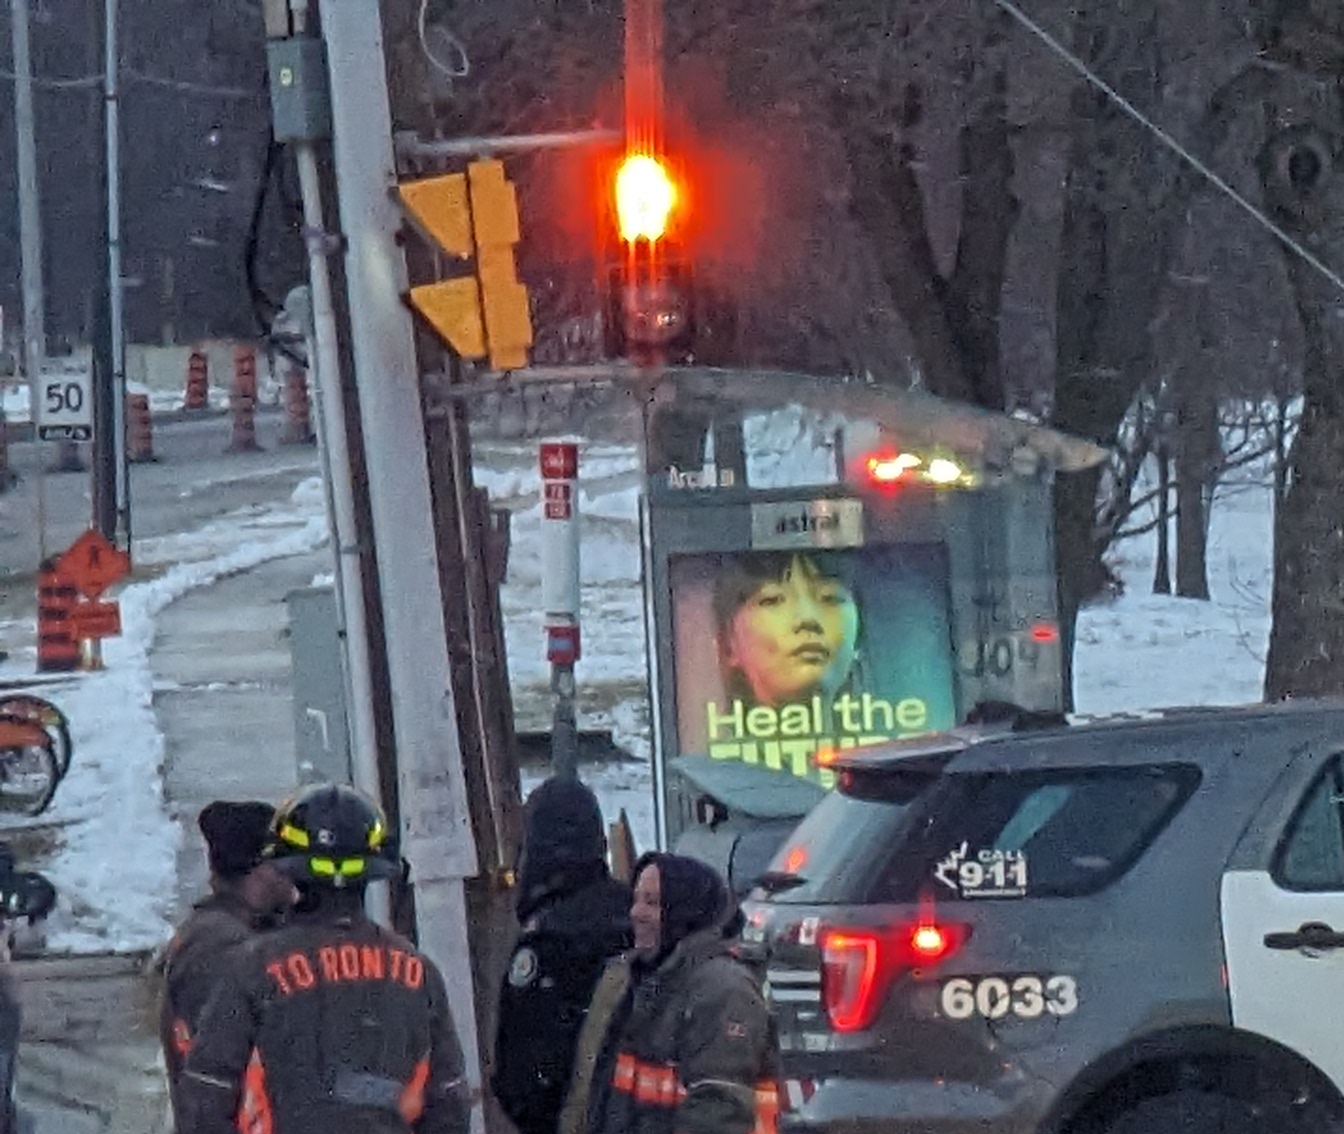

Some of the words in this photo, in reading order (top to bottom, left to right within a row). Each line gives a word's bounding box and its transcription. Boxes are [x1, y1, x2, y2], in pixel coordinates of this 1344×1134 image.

[46, 382, 83, 413] 50
[707, 695, 823, 739] Heal
[833, 692, 927, 732] the
[265, 943, 425, 995] TORONTO
[941, 975, 1079, 1020] 6033
